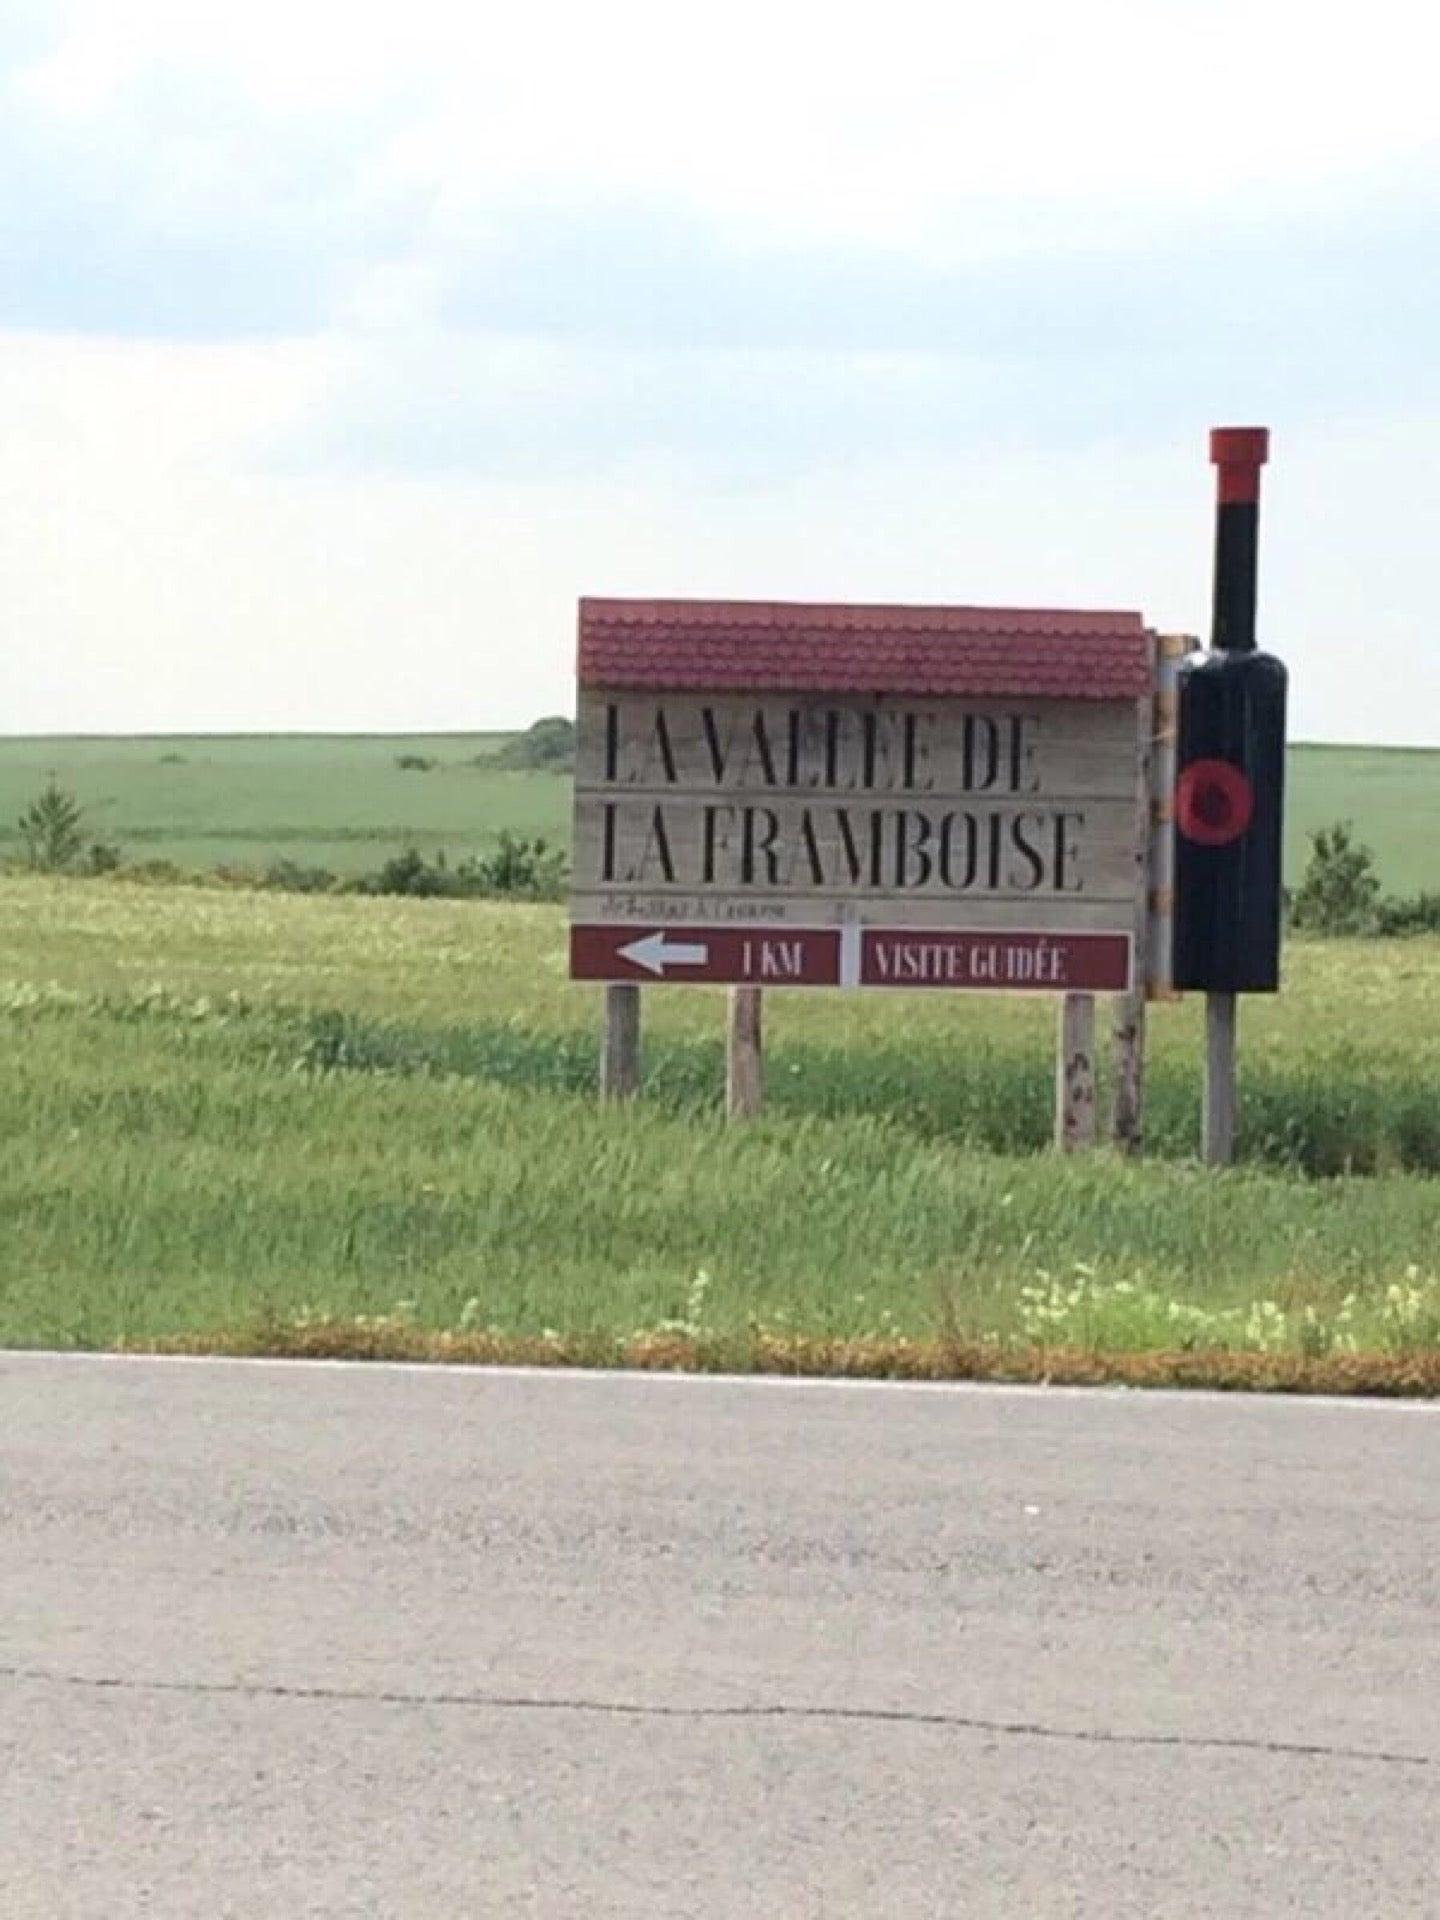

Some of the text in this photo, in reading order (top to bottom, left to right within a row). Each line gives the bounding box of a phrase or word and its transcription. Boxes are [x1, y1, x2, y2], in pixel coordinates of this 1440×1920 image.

[605, 704, 678, 785] LA
[961, 711, 1042, 792] DE
[602, 803, 1085, 892] LA FRAMBOISE
[761, 941, 804, 976] KM
[875, 937, 1067, 980] VISITE GUIDÉE
